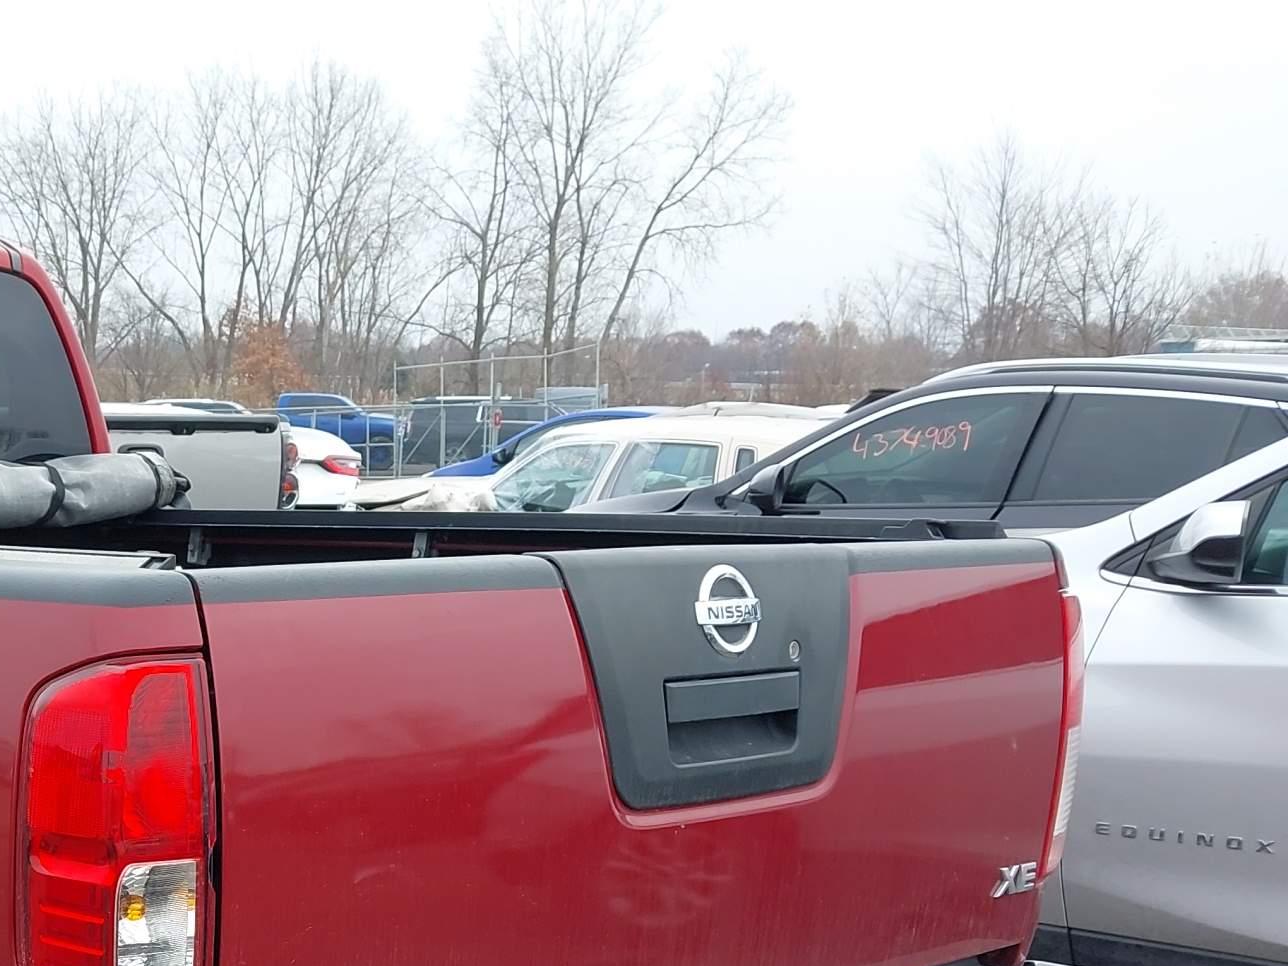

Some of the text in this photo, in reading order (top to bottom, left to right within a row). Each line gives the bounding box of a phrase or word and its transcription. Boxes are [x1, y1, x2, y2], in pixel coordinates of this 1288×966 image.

[707, 603, 759, 620] NISSAN
[1095, 821, 1275, 854] EQUINOX
[990, 861, 1037, 899] XE
